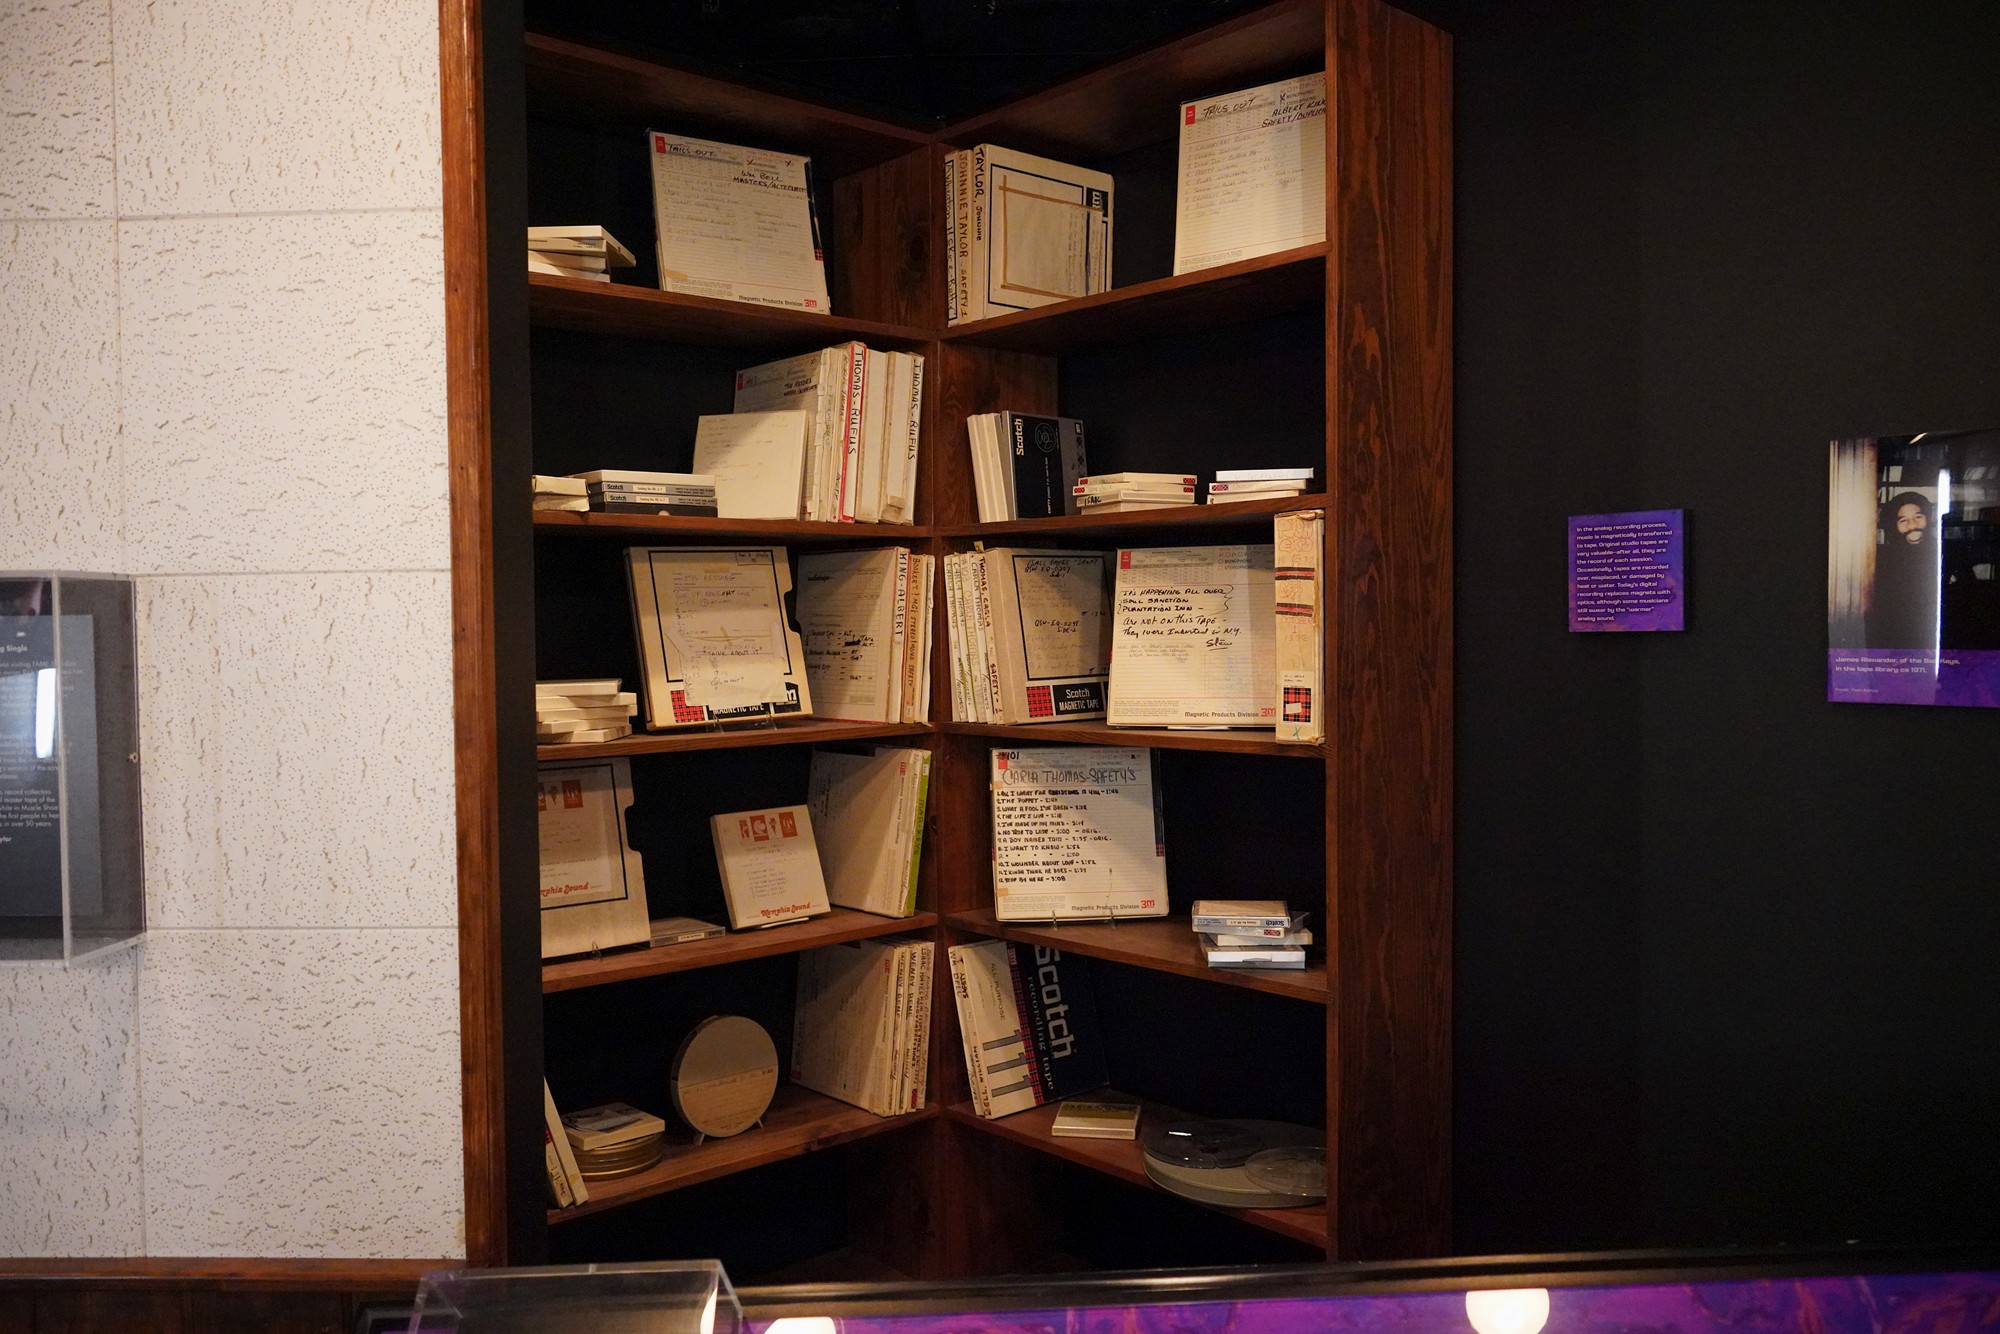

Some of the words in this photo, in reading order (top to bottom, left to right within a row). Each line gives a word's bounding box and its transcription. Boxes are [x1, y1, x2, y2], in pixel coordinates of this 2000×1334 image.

[959, 215, 969, 258] TAYLOR
[853, 350, 863, 398] THOMAS
[911, 359, 923, 415] THOMAS
[848, 407, 860, 455] RUFUS
[908, 420, 919, 460] RUFUS
[1015, 418, 1024, 456] Scotch
[899, 554, 907, 581] KING
[1123, 604, 1171, 612] PLANTATION
[1140, 587, 1181, 596] HAPPENING
[895, 589, 905, 636] ALBERT
[1875, 666, 1898, 674] library
[1059, 700, 1085, 711] MAGNETIC
[1086, 699, 1099, 709] TAPE
[1066, 688, 1090, 699] Scotch
[563, 882, 589, 894] Sound
[761, 907, 790, 918] Memphis
[791, 902, 811, 914] Sound
[1035, 945, 1075, 1059] Scotch
[1028, 976, 1047, 1052] recording
[1043, 1057, 1054, 1090] tape
